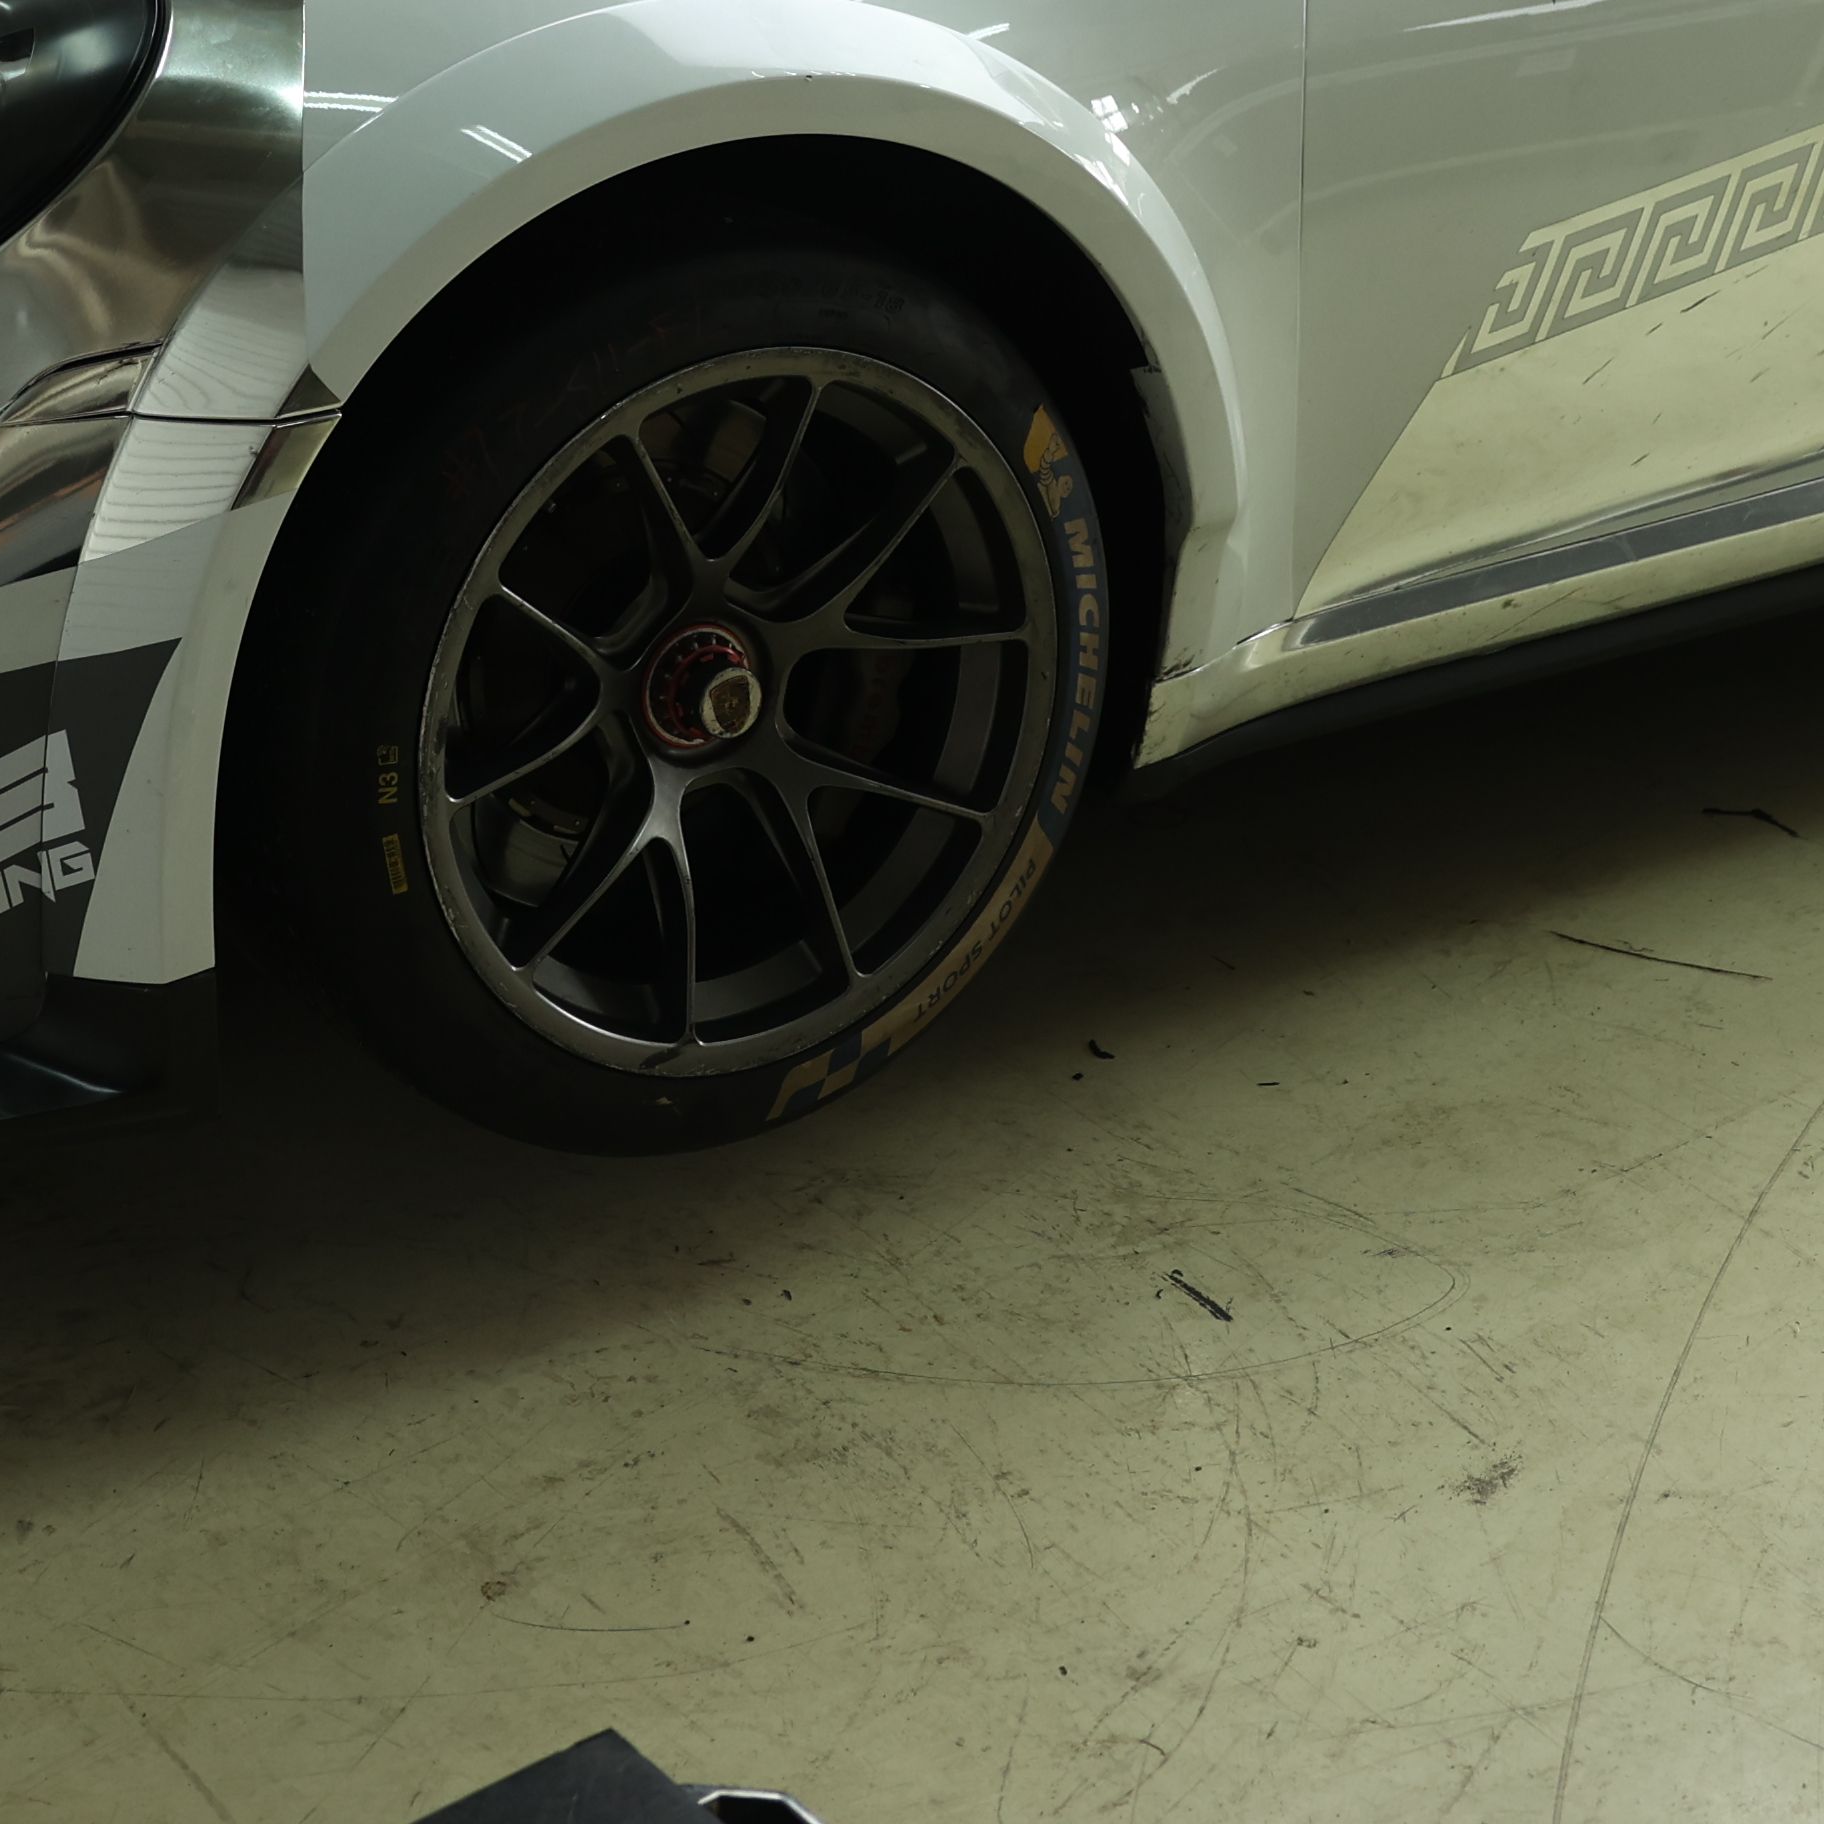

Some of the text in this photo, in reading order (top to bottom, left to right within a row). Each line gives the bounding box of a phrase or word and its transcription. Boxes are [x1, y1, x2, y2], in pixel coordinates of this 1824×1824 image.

[1049, 516, 1104, 817] MICHELIN
[377, 770, 399, 805] N3
[912, 858, 1038, 1023] PILOT SPORT
